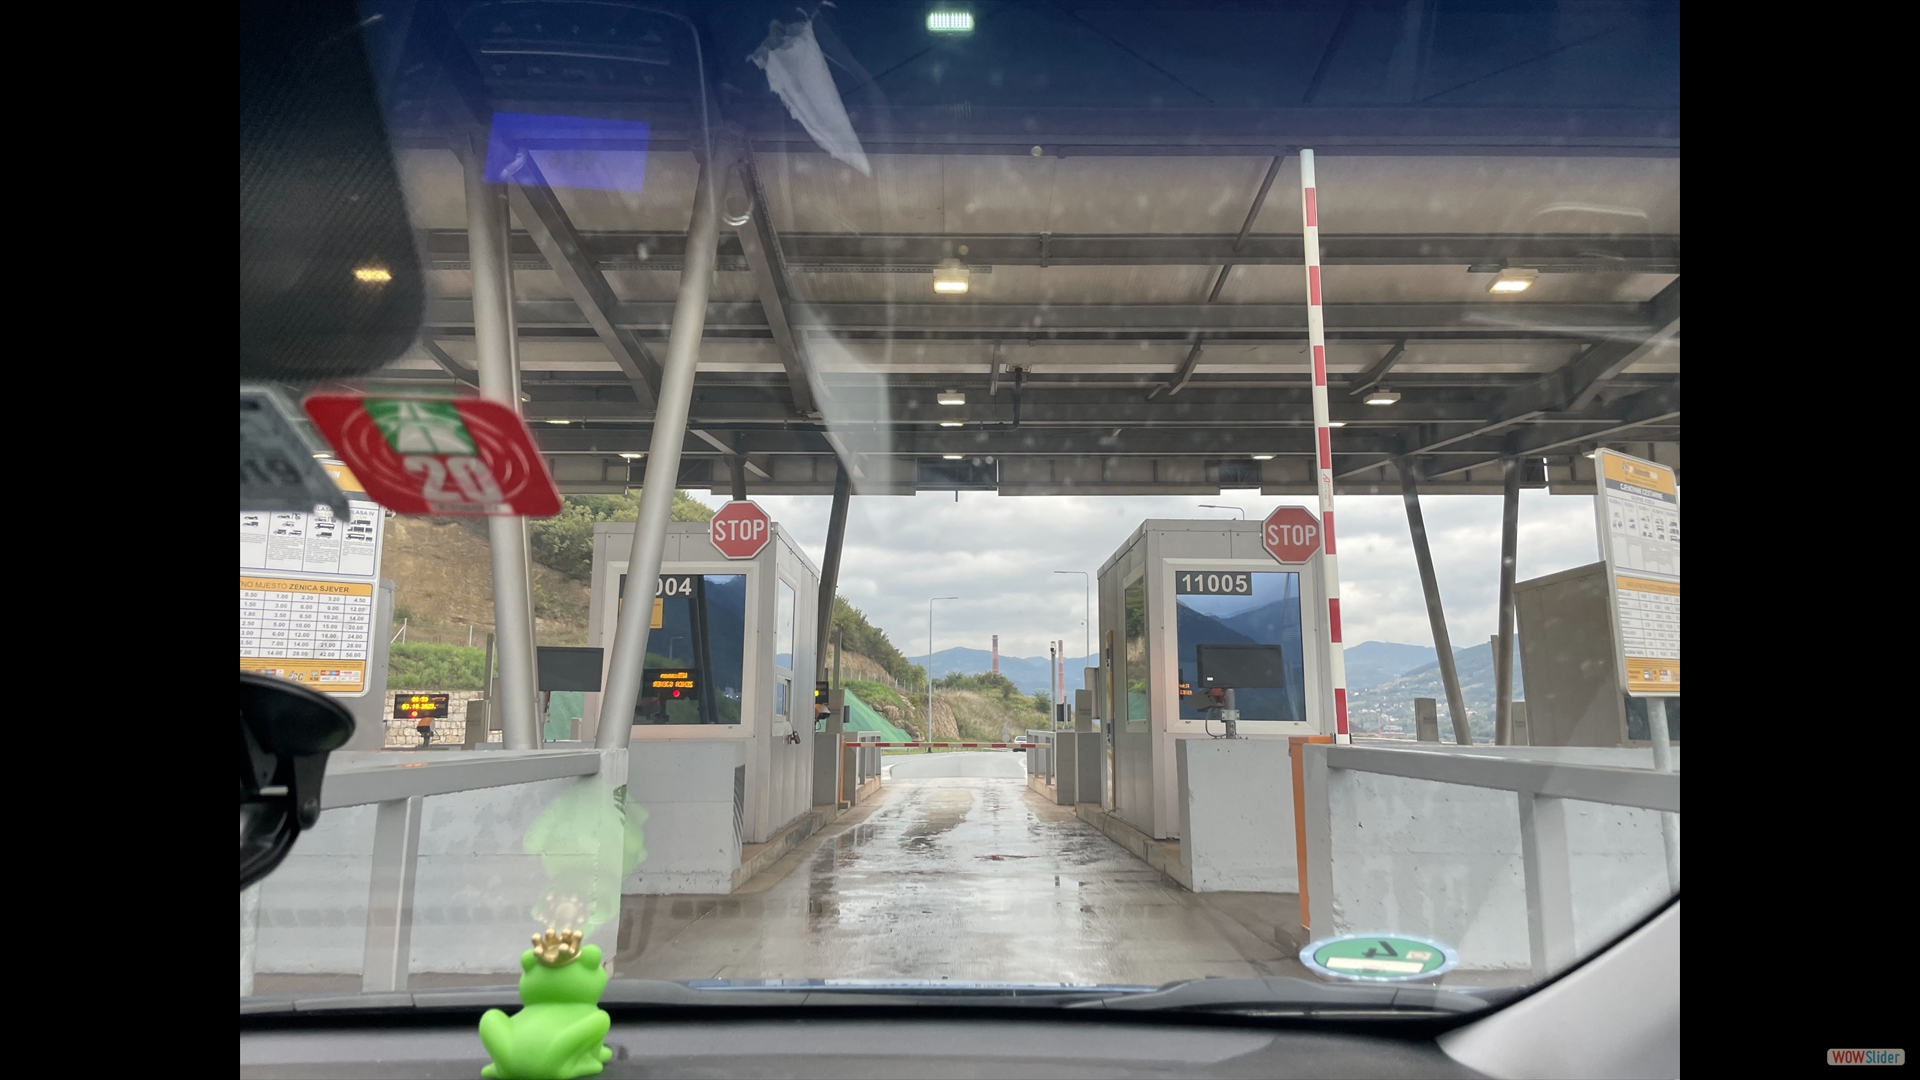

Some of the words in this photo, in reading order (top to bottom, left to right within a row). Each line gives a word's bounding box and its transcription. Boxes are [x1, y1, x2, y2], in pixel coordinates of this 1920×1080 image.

[402, 455, 504, 504] 20
[714, 519, 765, 541] STOP
[1267, 524, 1317, 546] STOP
[255, 581, 288, 589] MJESTO
[320, 585, 350, 593] SJEVER
[1182, 573, 1248, 593] 11005
